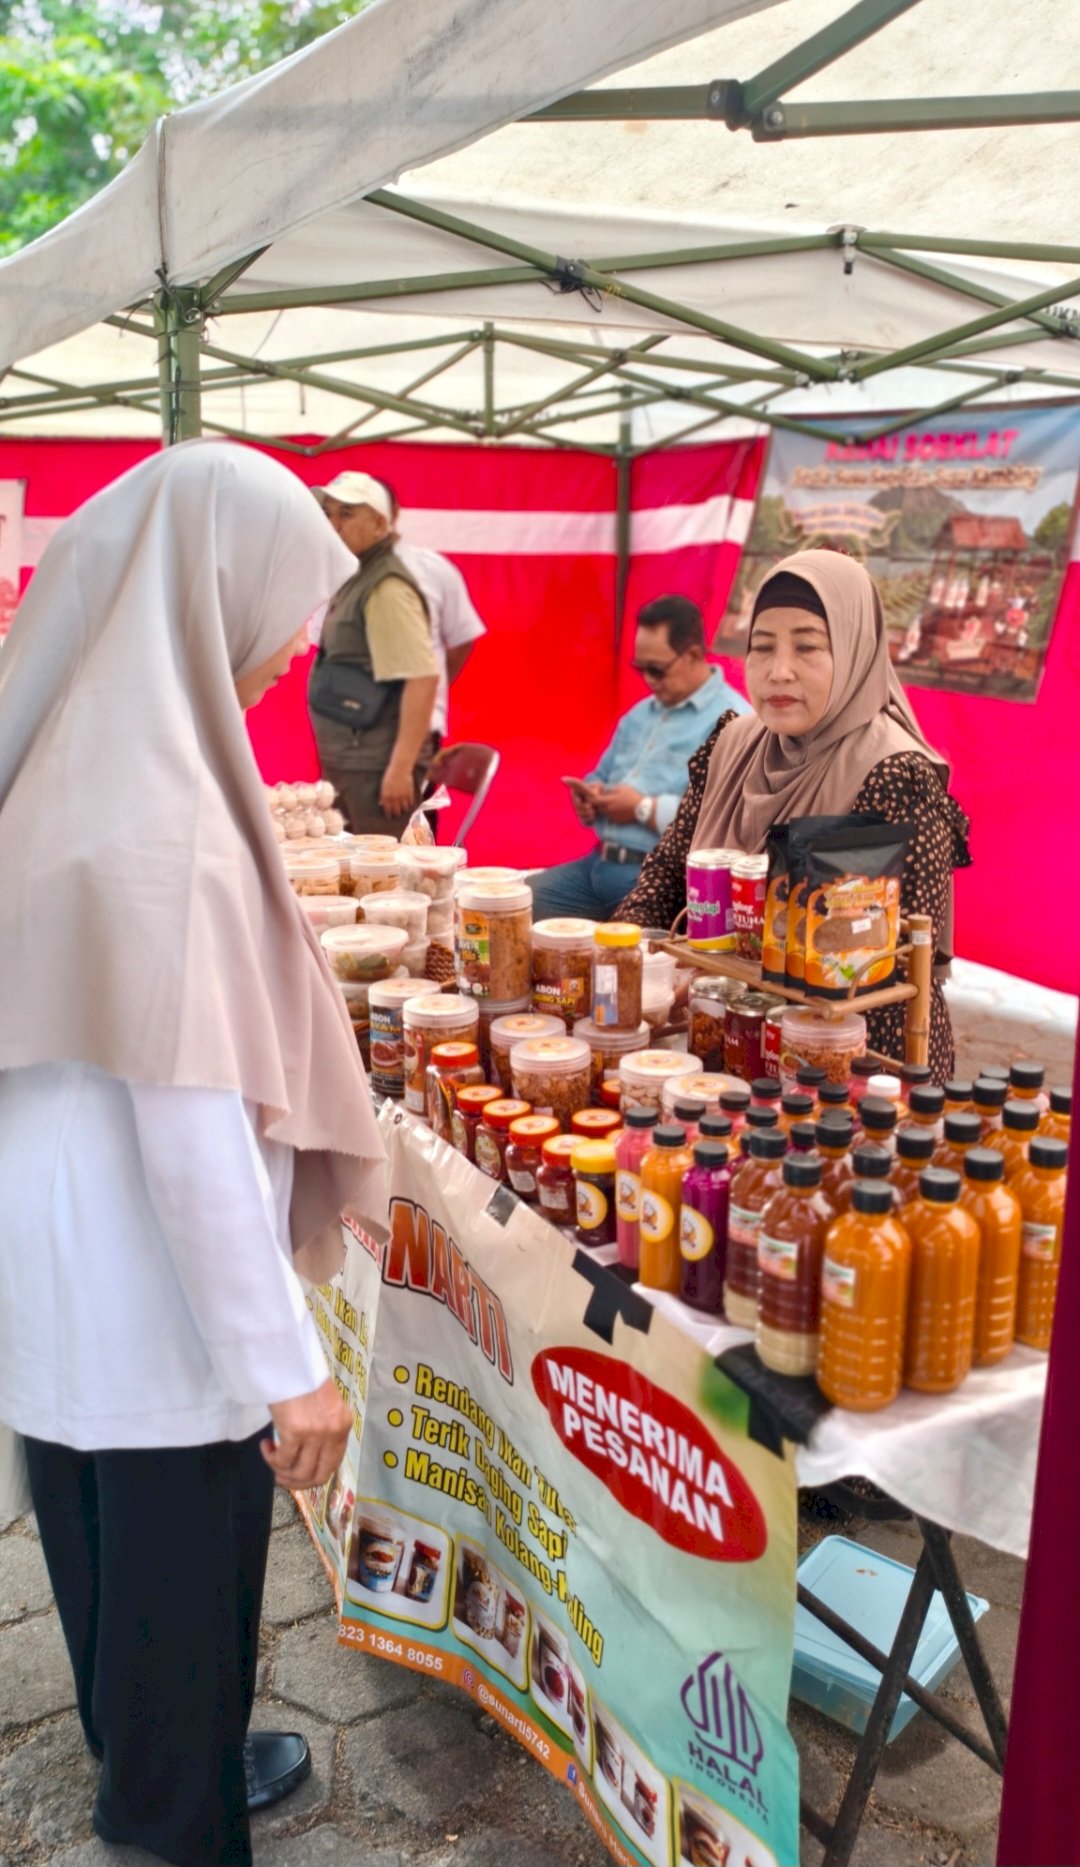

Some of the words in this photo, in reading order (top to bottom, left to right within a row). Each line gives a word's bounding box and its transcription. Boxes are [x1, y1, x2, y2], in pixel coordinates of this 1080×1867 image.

[903, 427, 1019, 462] SOEKLAT
[415, 1362, 497, 1449] Rendang
[496, 1424, 532, 1490] Ikan
[545, 1358, 735, 1509] MENERIMA
[404, 1446, 492, 1526] Manisan
[411, 1405, 470, 1461] Terik
[474, 1436, 524, 1522] Daging
[527, 1504, 569, 1564] Sapi
[562, 1403, 724, 1543] PESANAN
[369, 1633, 403, 1657] 1364
[407, 1647, 444, 1671] 8055
[477, 1683, 552, 1760] @sunarti5742
[687, 1740, 769, 1813] HALAL
